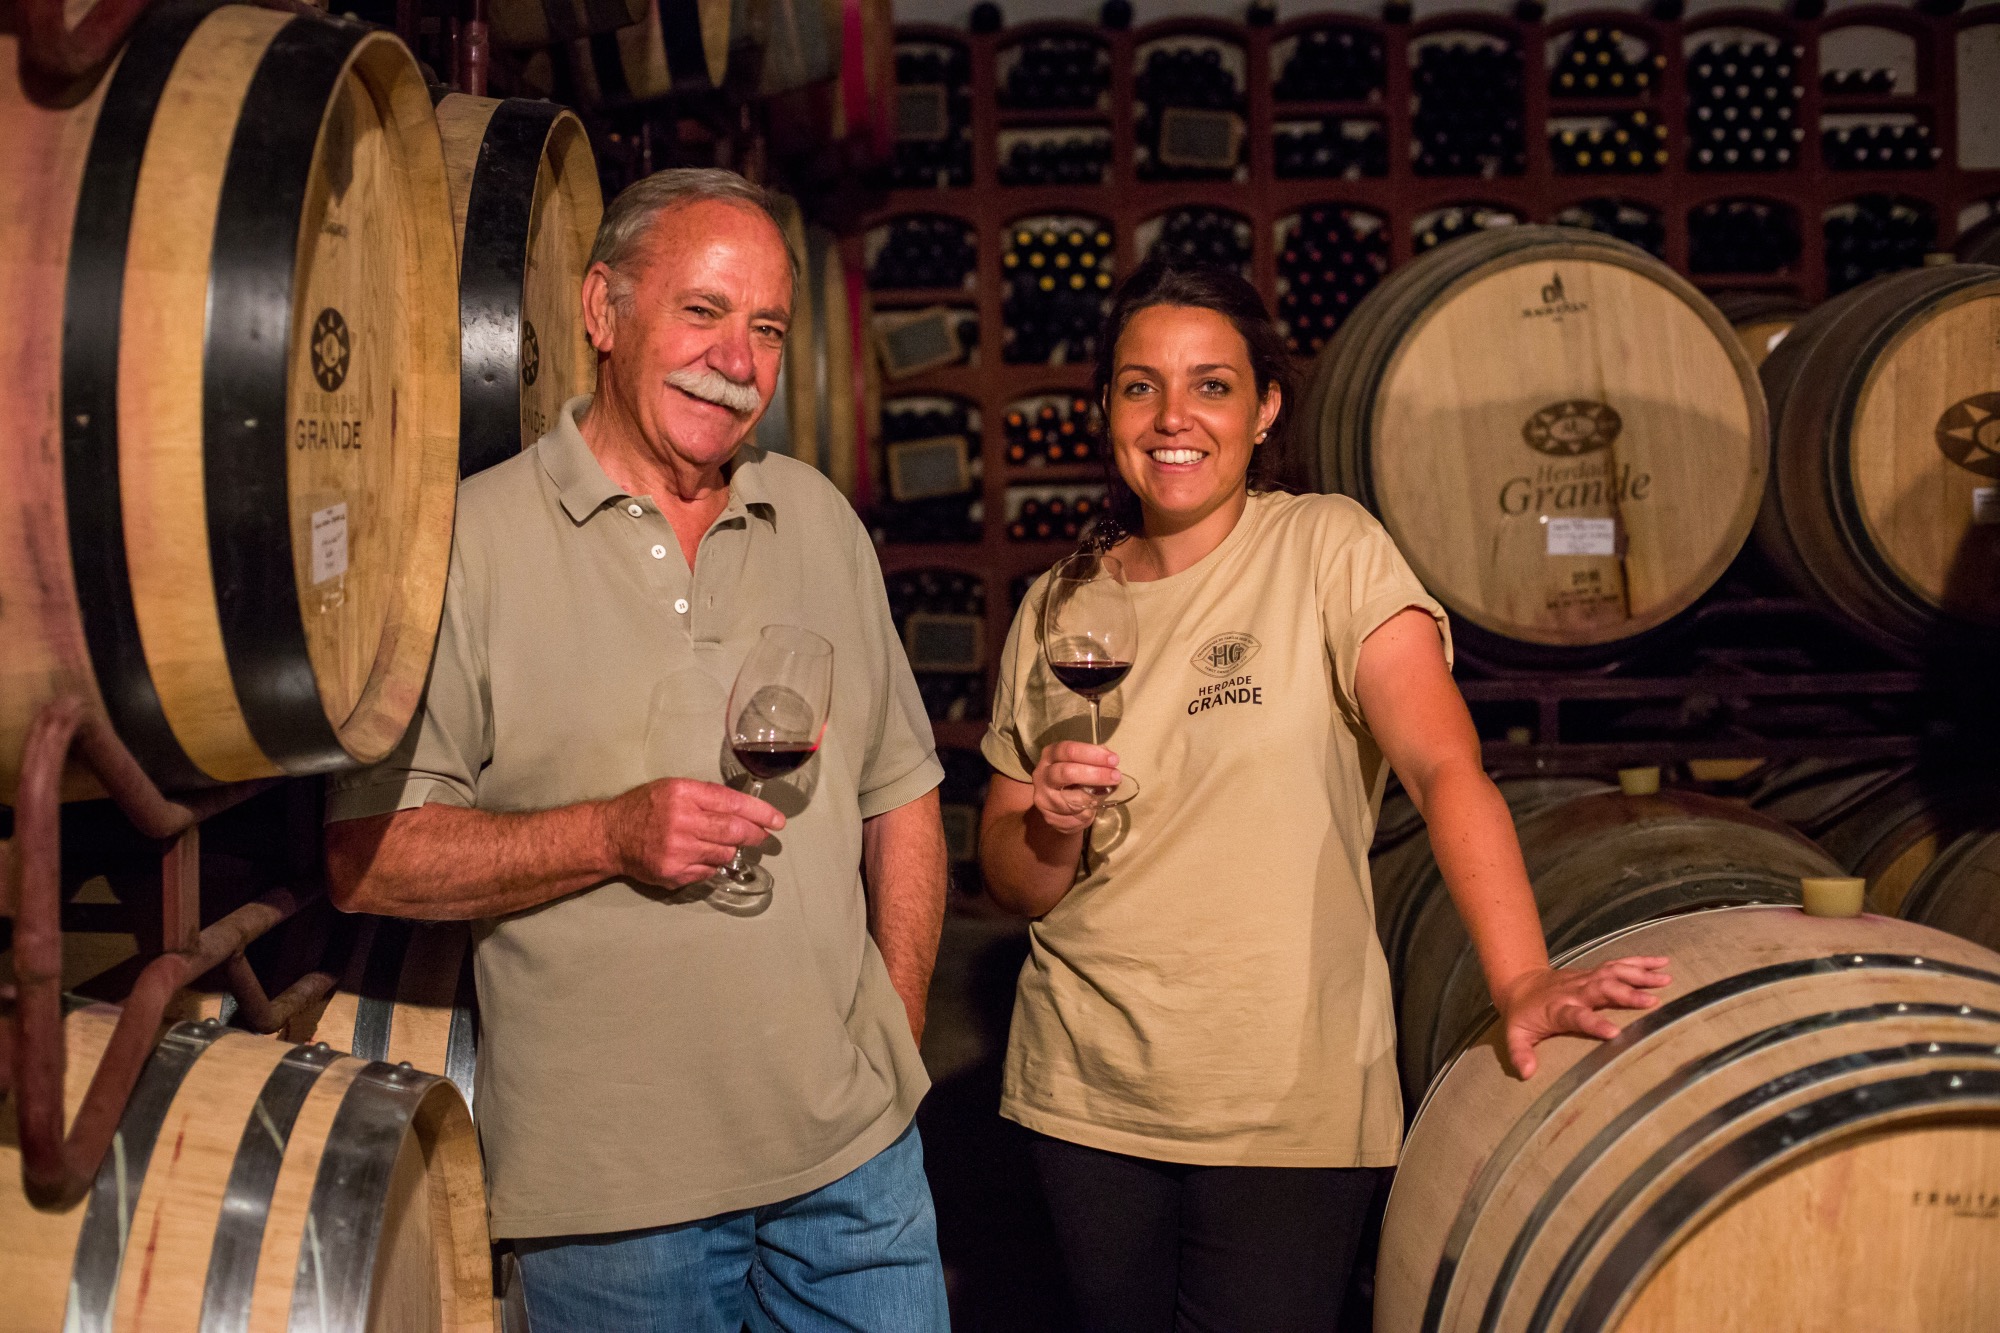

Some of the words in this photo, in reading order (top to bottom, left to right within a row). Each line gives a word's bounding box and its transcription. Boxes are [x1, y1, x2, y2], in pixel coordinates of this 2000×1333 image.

[294, 418, 362, 451] GRANDE
[1498, 463, 1651, 516] Grande
[1199, 675, 1252, 696] HERDADE
[1188, 687, 1262, 715] GRANDE
